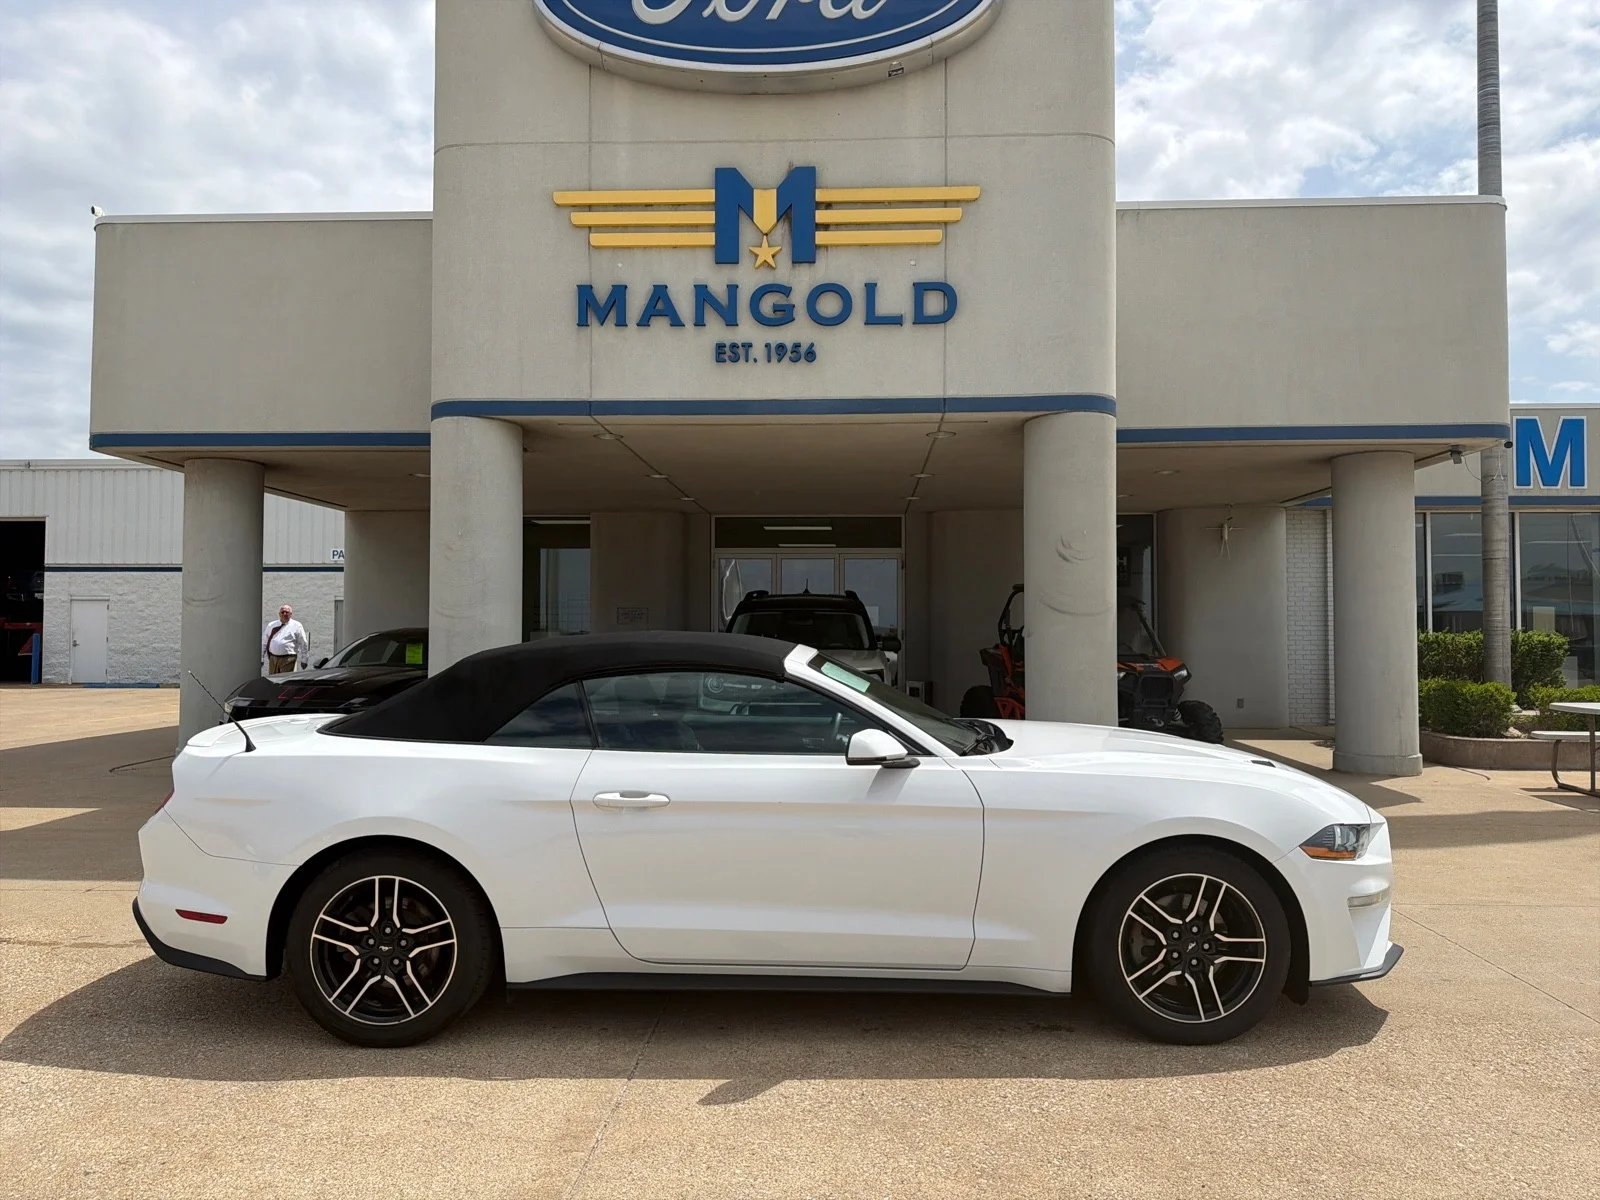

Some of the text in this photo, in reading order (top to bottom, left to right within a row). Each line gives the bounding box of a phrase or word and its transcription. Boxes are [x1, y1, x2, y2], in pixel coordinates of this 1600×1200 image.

[715, 166, 816, 264] M
[576, 282, 957, 327] MANGOLD
[715, 342, 817, 363] EST. 1956
[1513, 416, 1587, 489] M
